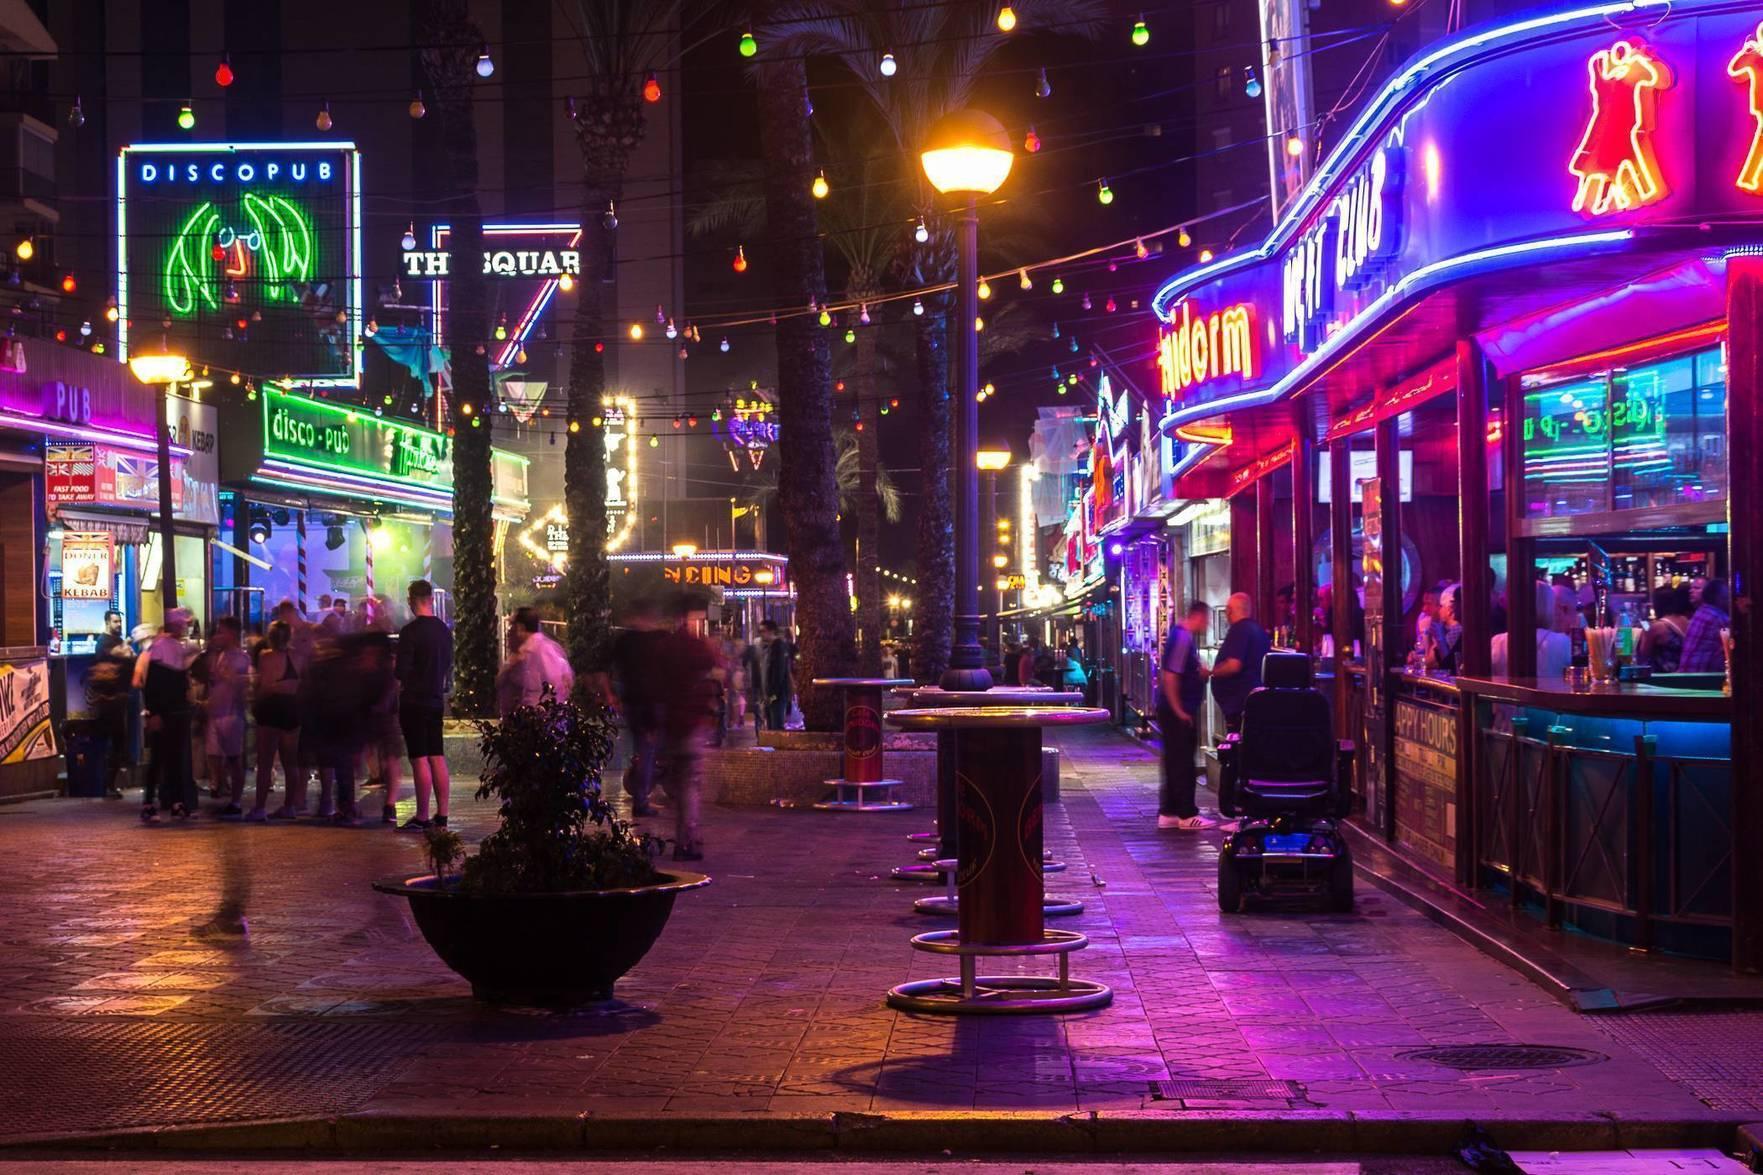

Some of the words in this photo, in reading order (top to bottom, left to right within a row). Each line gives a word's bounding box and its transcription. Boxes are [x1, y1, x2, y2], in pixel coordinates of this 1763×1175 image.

[1336, 147, 1386, 287] CLUB
[403, 252, 450, 275] TH
[482, 251, 580, 276] SQUAR
[57, 381, 91, 424] PUB
[53, 485, 70, 493] FAST
[70, 485, 89, 493] FOOD
[58, 493, 74, 501] TAKE
[76, 493, 95, 501] AWAY
[664, 565, 750, 585] NCING
[64, 588, 108, 598] KEBAB
[1395, 702, 1419, 740] APPY
[1420, 711, 1457, 754] HOURS
